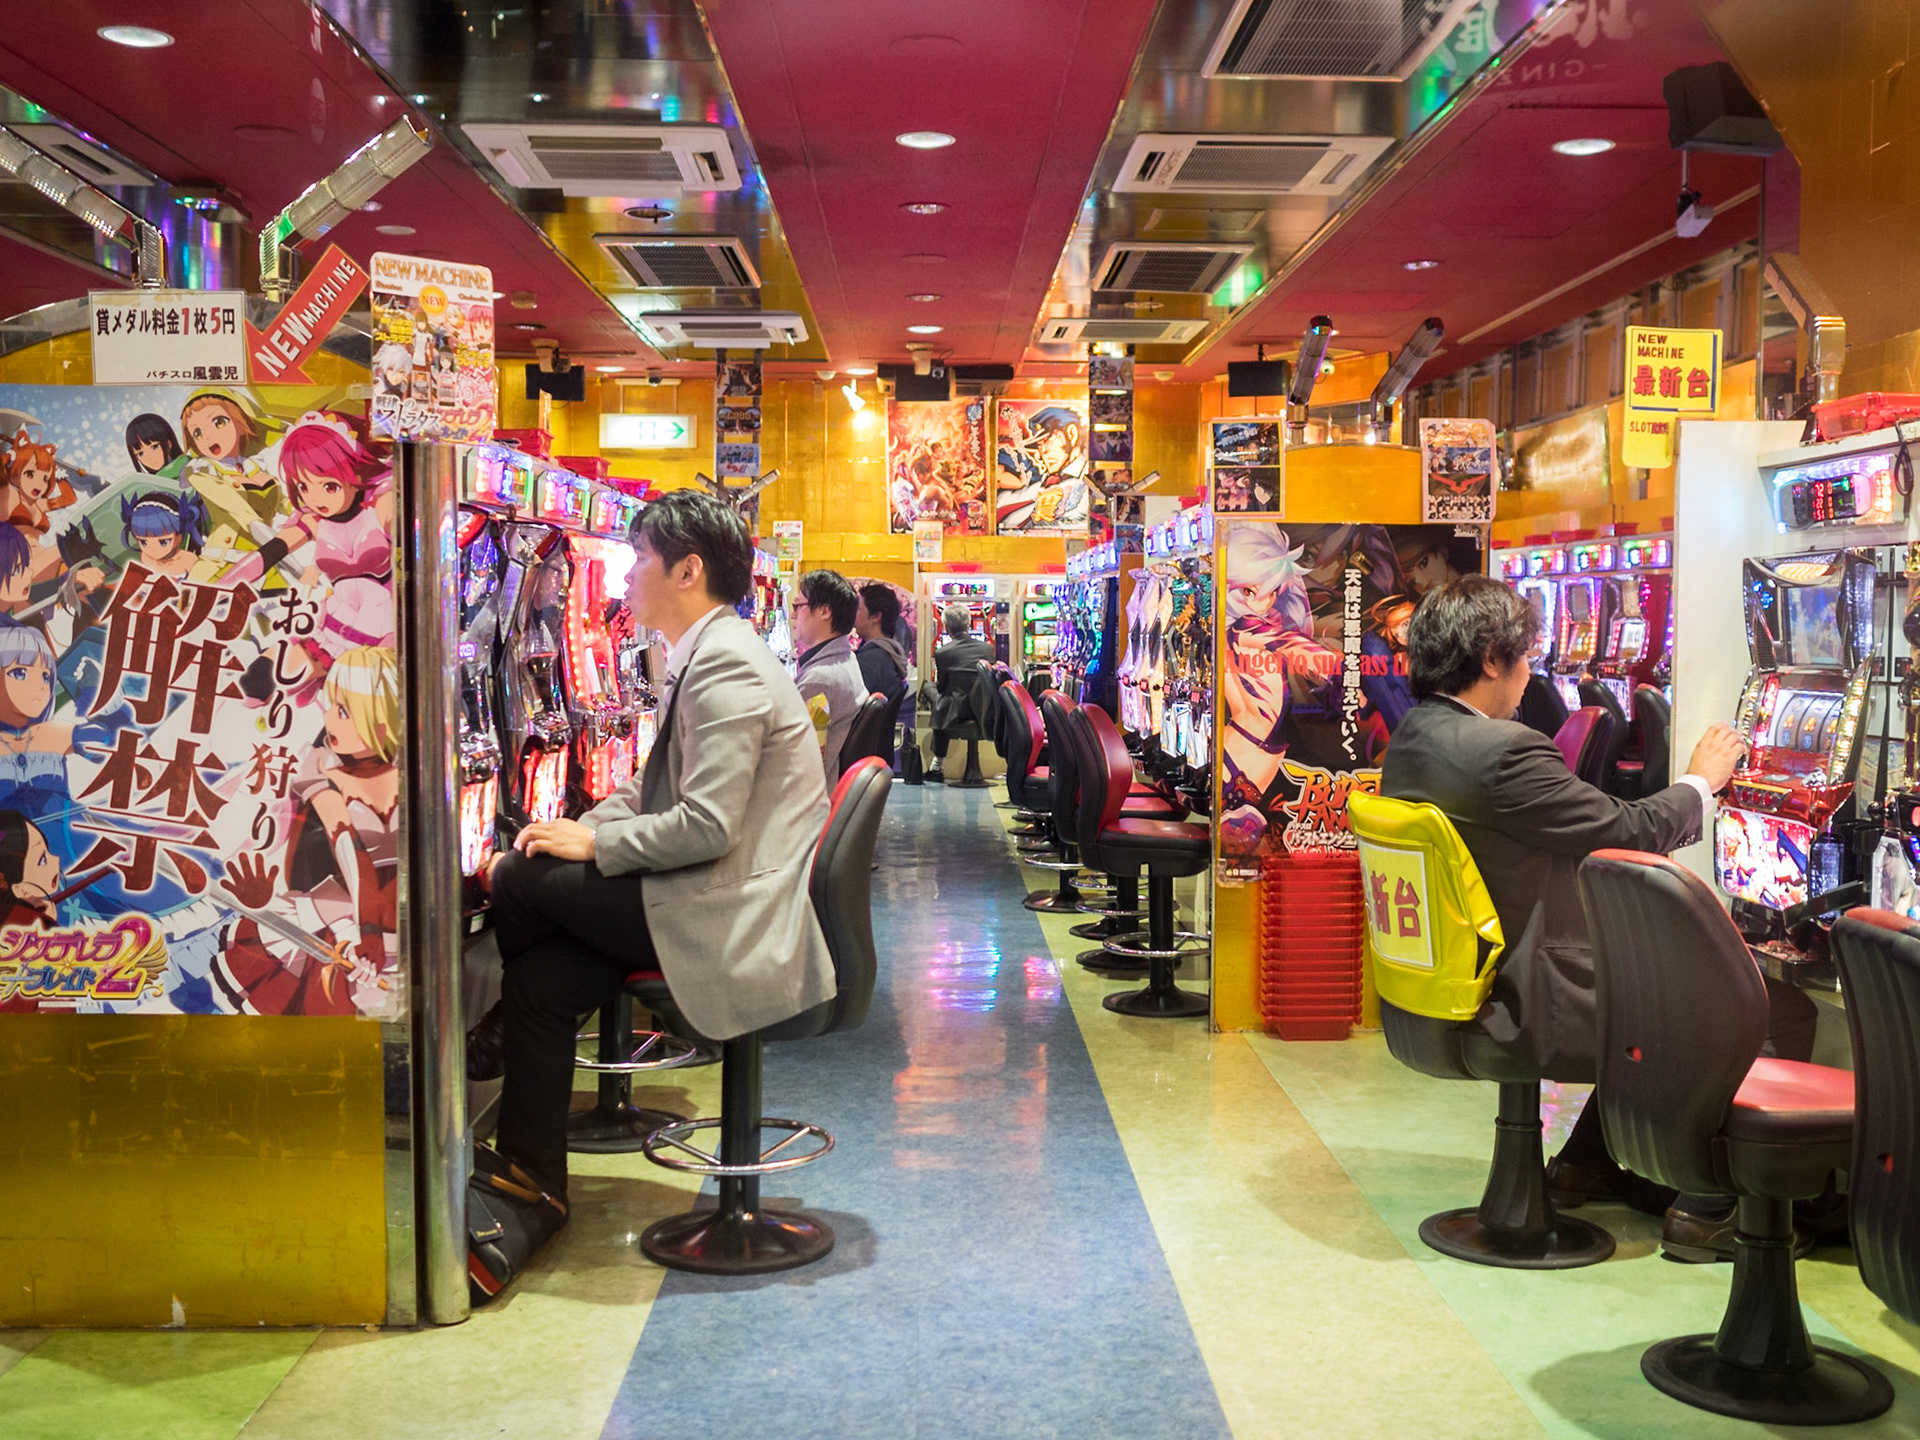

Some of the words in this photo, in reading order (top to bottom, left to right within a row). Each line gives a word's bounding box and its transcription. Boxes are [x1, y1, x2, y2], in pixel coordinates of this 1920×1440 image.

[374, 256, 414, 280] NEW
[415, 263, 489, 291] MACHINE
[254, 312, 314, 379] NEW
[299, 257, 357, 328] MACHINE
[422, 294, 445, 307] NEW
[96, 307, 236, 336] 貸メダル料金1枚5円
[1637, 333, 1668, 344] NEW
[1637, 345, 1685, 359] MACHINE
[147, 365, 239, 380] パチスロ風雲児
[1633, 364, 1711, 399] 最新台
[1224, 650, 1284, 676] Angel
[1287, 653, 1309, 676] to
[1312, 653, 1389, 676] surass
[1341, 568, 1362, 761] 天使は悪魔を超えていく。
[65, 561, 258, 895] 解禁
[245, 587, 319, 852] おしり狩り
[95, 917, 152, 993] 2
